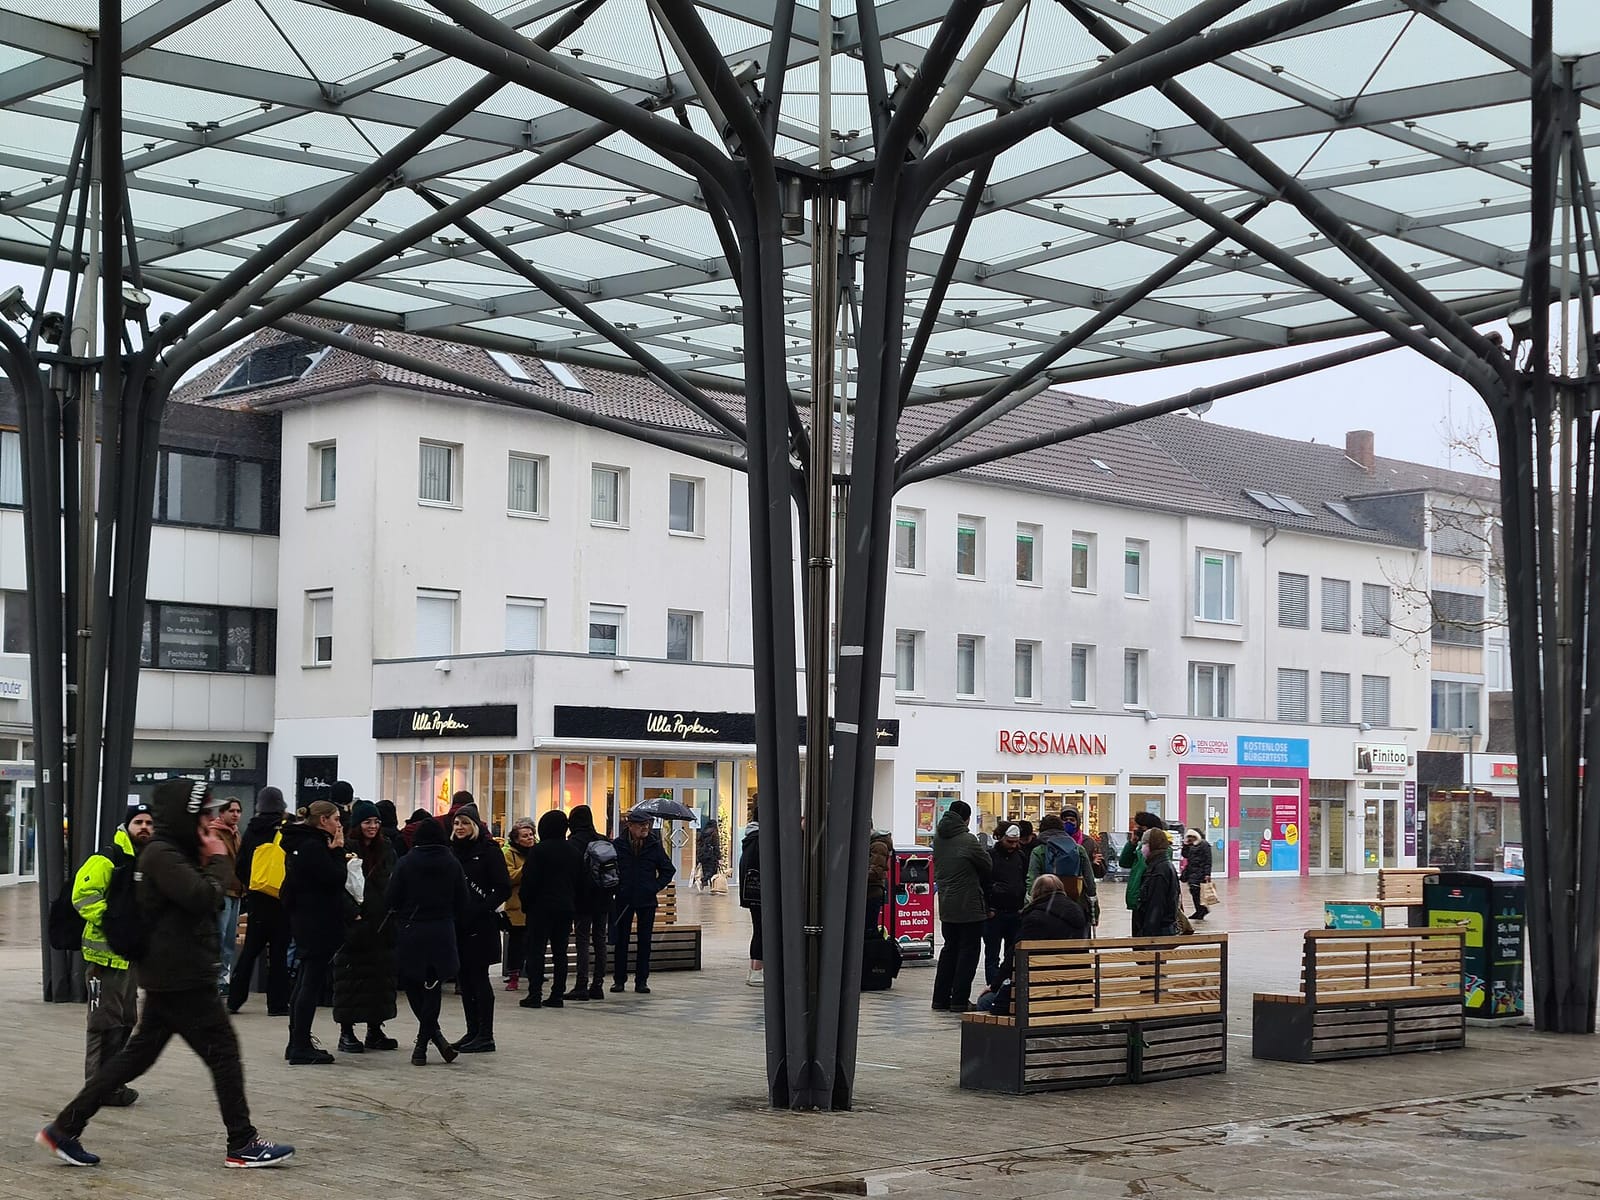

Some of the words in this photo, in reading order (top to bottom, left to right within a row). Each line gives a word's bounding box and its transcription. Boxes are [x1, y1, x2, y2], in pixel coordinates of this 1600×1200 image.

[412, 711, 431, 731] Ulla
[431, 710, 469, 736] Popken
[647, 712, 672, 732] Ulla
[673, 713, 719, 739] Popken
[999, 730, 1107, 755] ROSSMANN
[1209, 740, 1228, 748] CORONA
[1243, 741, 1288, 752] KOSTENLOSE
[1243, 751, 1288, 763] BÜRGERTESTS
[1372, 749, 1406, 762] Finitoo
[911, 909, 930, 917] mach
